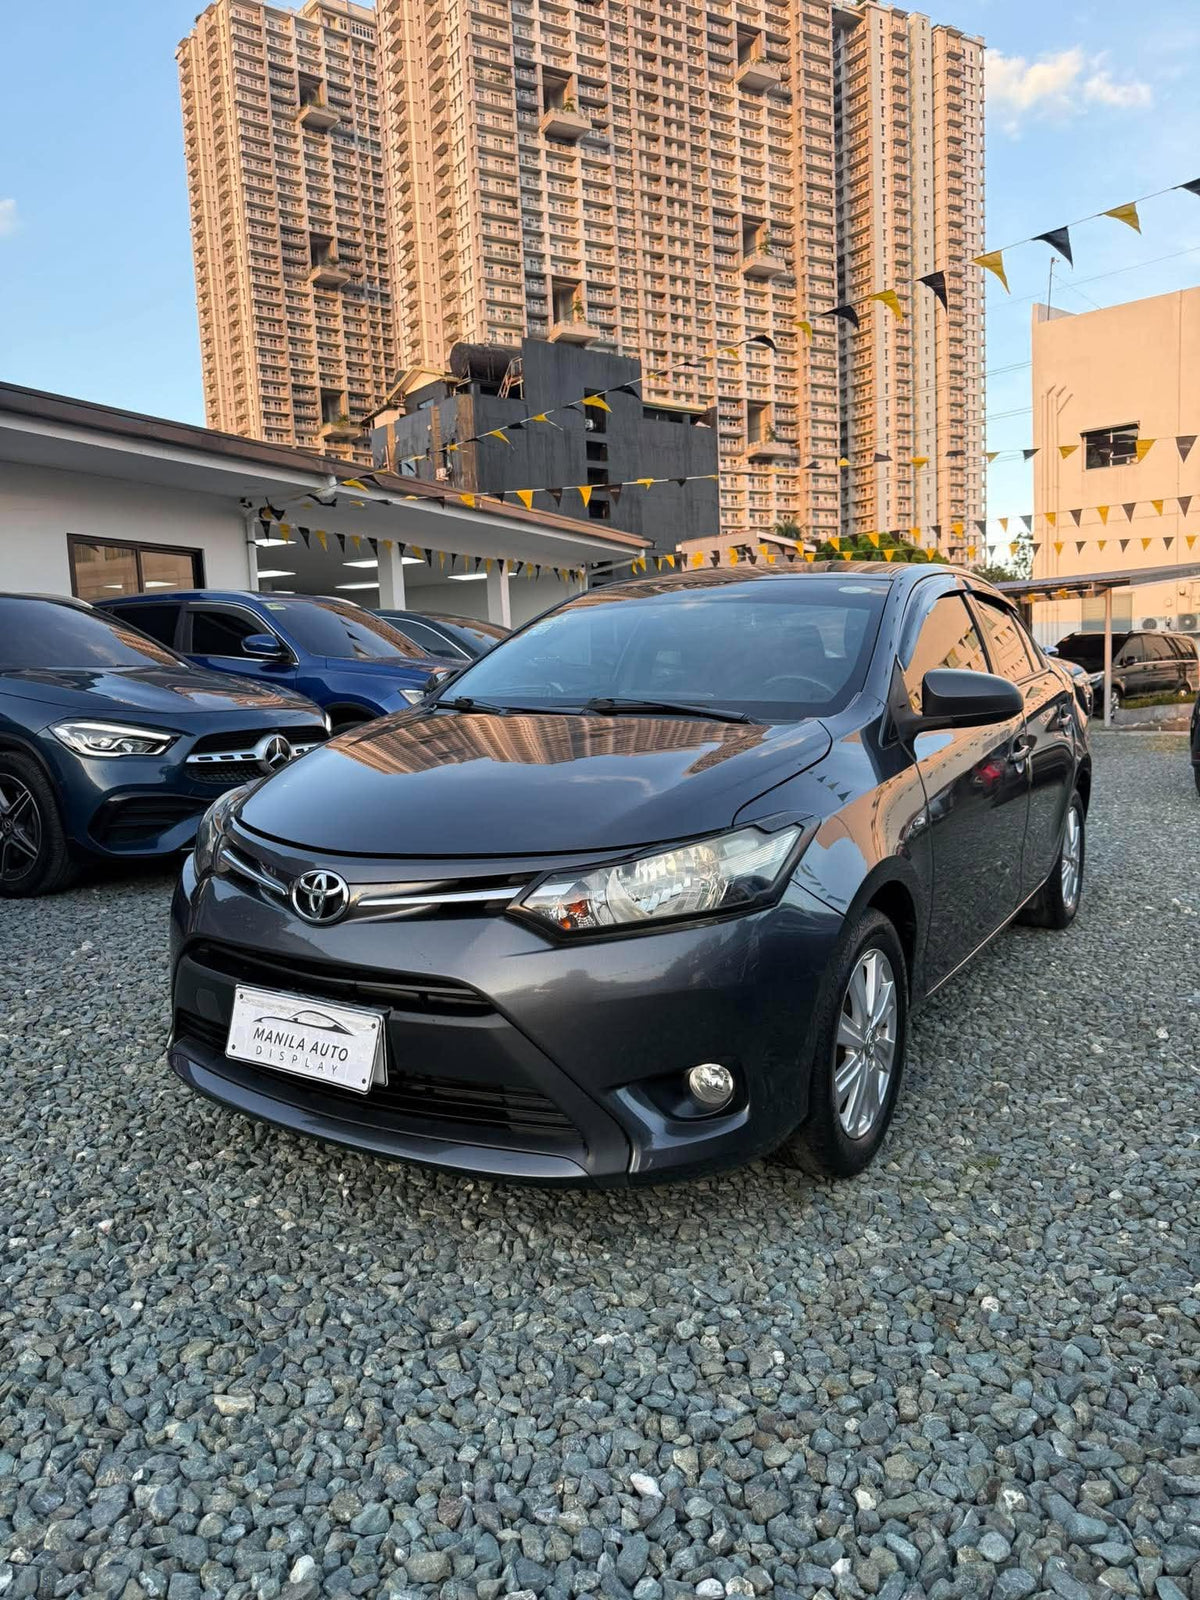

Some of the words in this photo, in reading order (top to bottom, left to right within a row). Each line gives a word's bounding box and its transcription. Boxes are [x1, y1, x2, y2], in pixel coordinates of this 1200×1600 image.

[253, 1027, 306, 1051] MANILA
[309, 1041, 349, 1062] AUTO
[256, 1045, 338, 1075] DISPLAY
